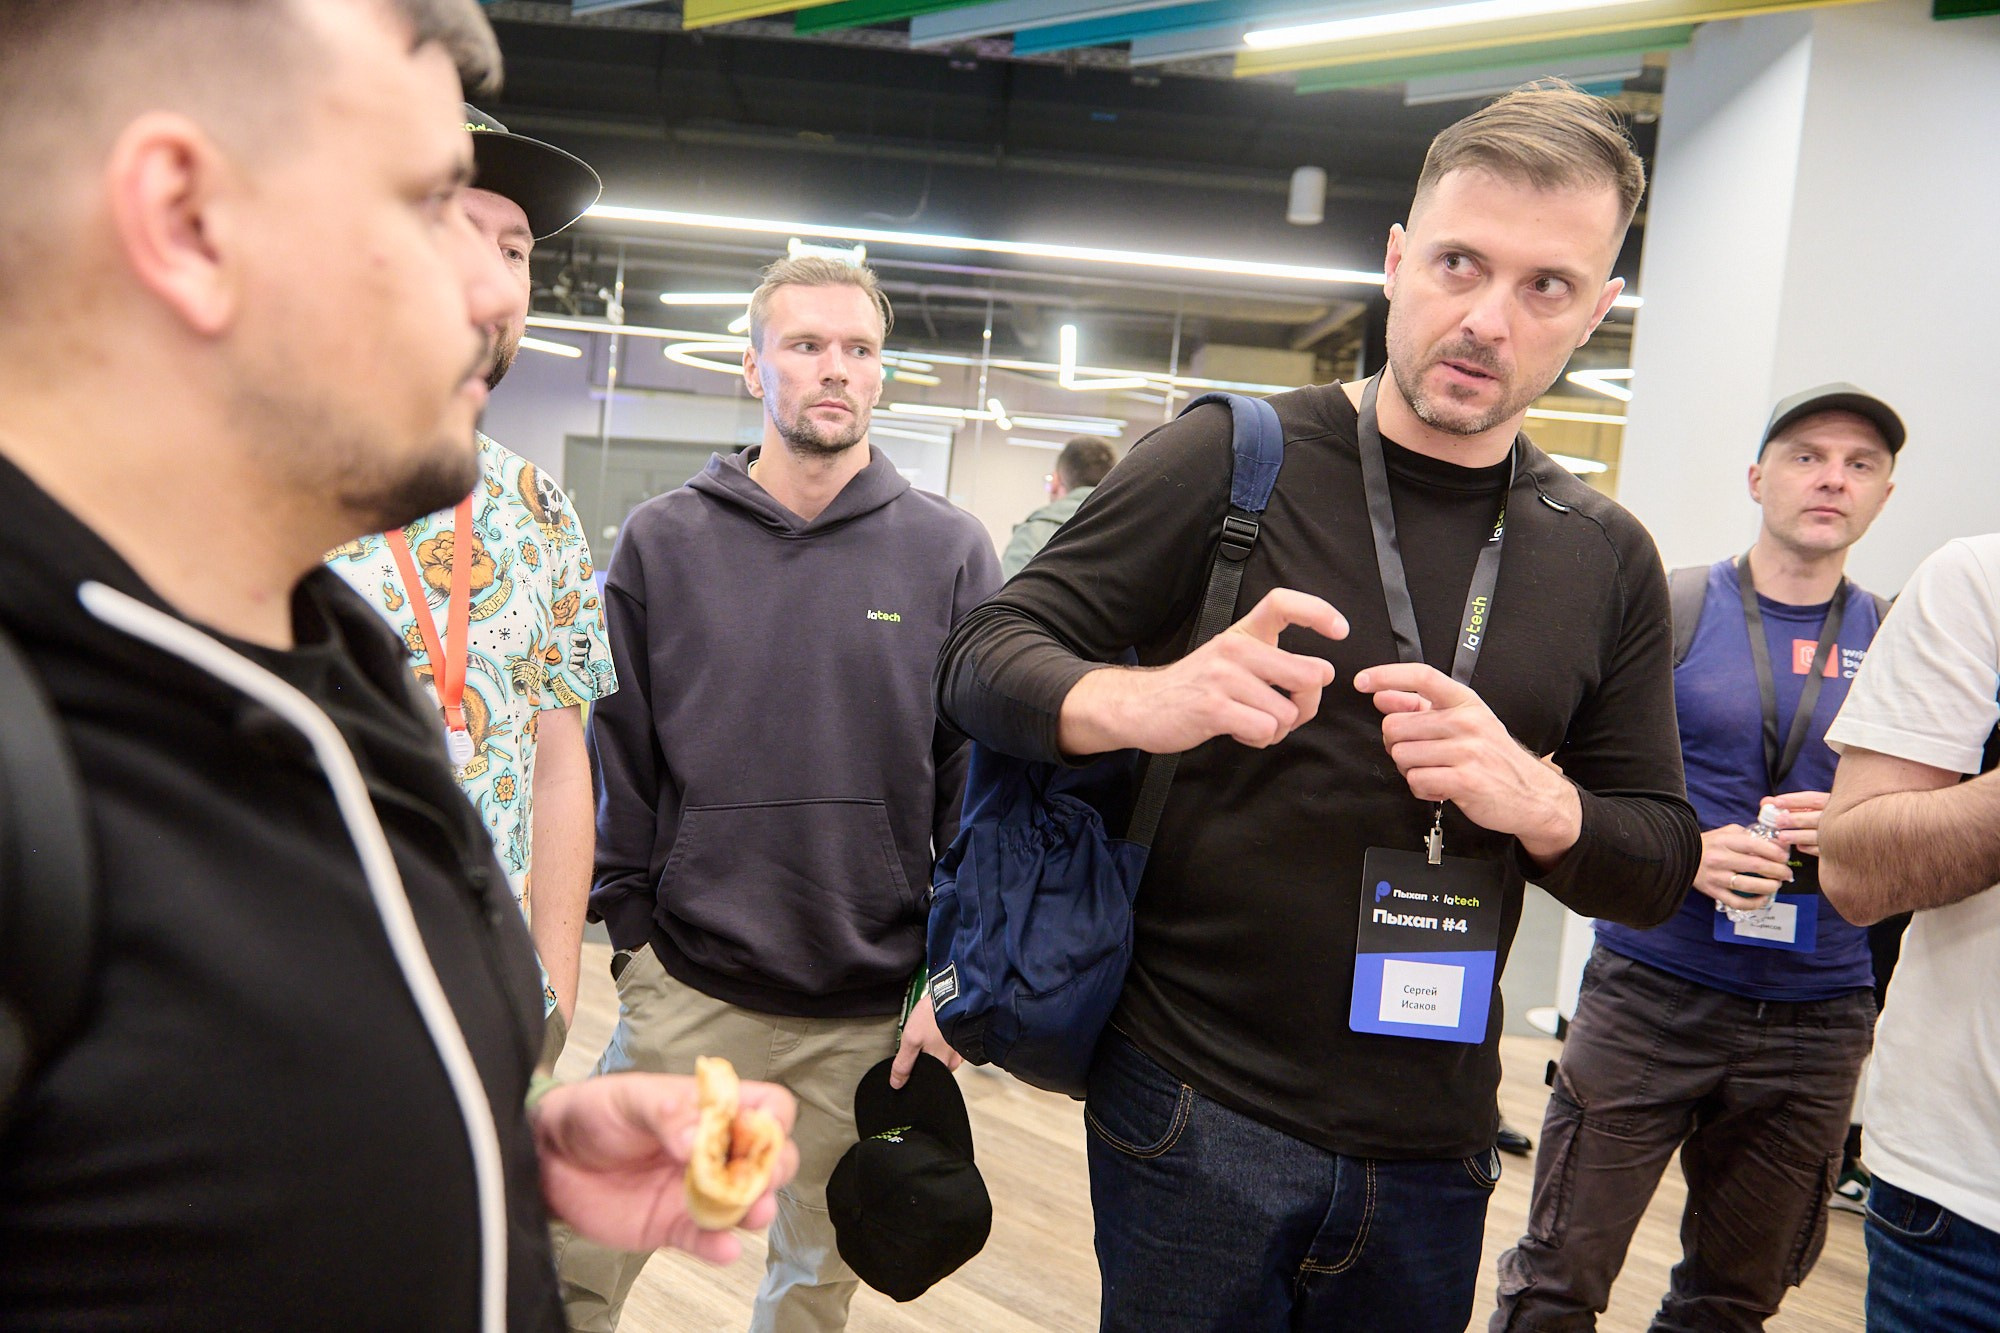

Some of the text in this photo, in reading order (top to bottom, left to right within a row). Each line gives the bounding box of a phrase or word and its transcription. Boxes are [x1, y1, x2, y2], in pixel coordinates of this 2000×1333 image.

[479, 595, 504, 618] TRUE
[867, 609, 901, 623] latech
[1462, 596, 1488, 651] latech
[464, 759, 488, 776] DUST
[1393, 888, 1428, 901] Пыхап
[1443, 894, 1480, 908] latech
[1372, 908, 1468, 933] Пыхап #4
[1403, 984, 1437, 997] Сергей
[1401, 999, 1436, 1011] Исаков
